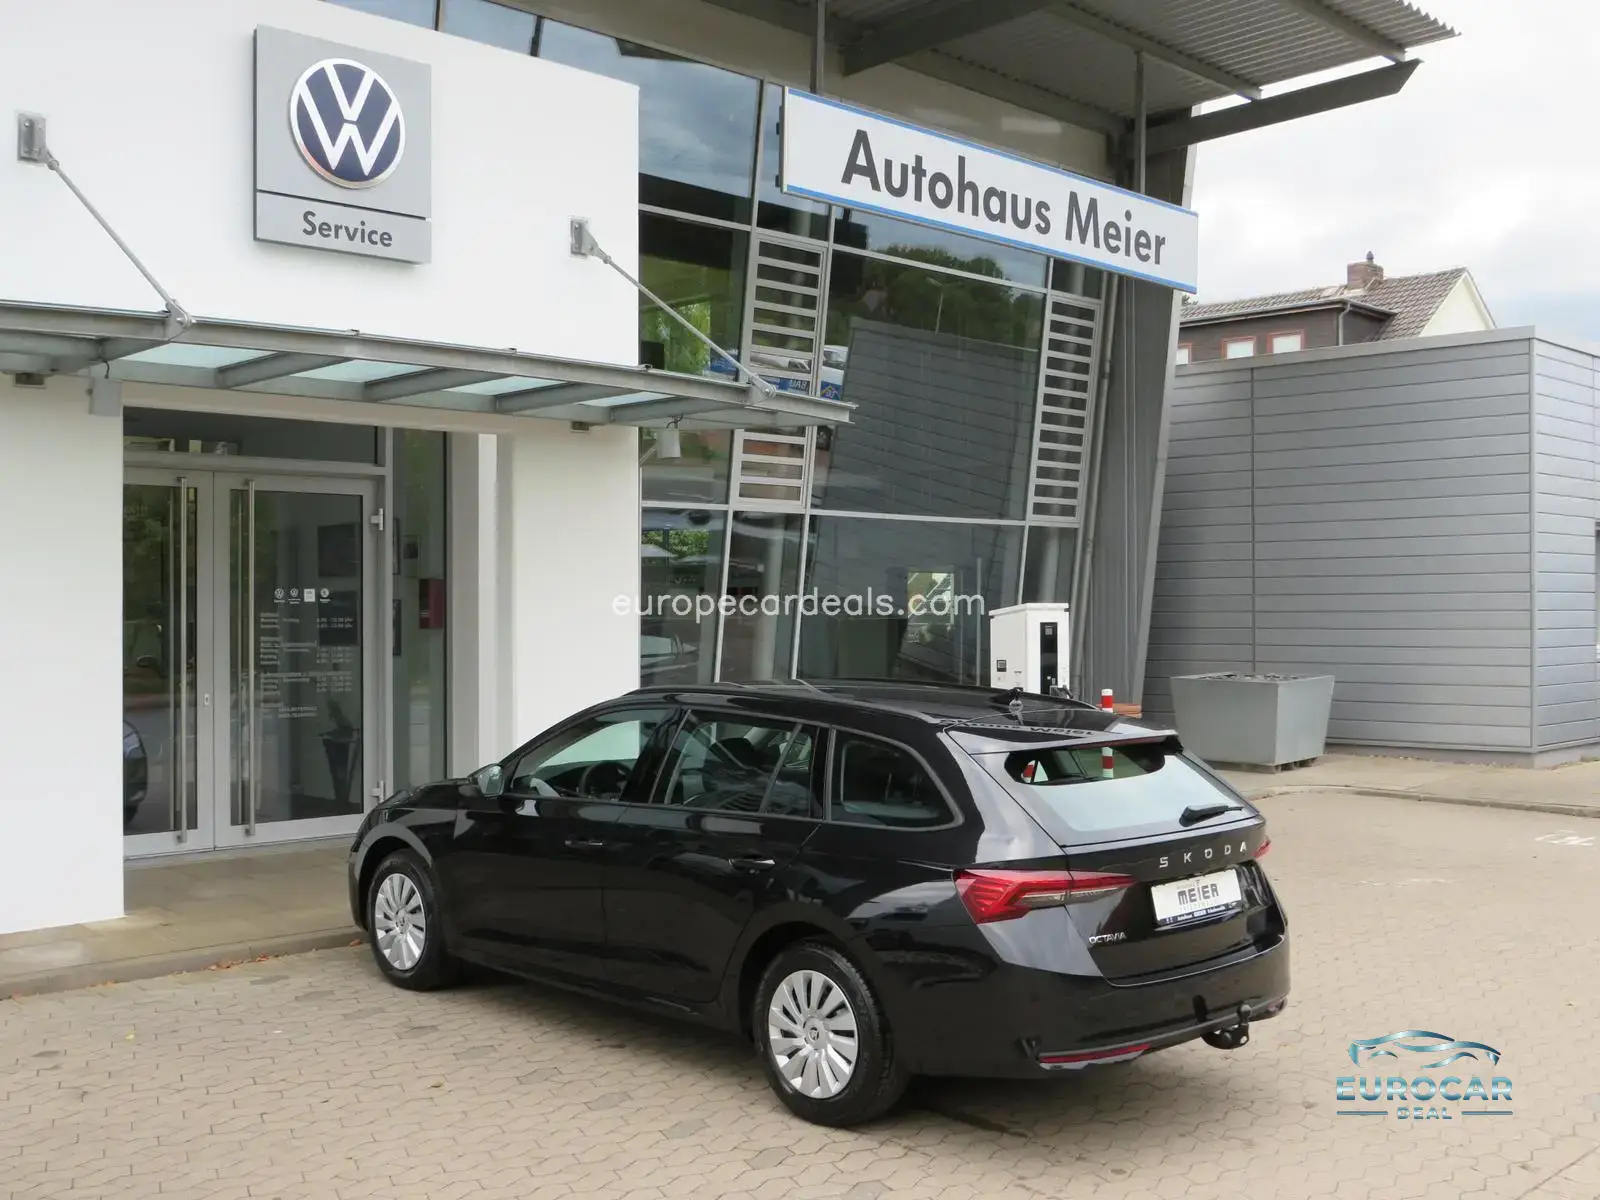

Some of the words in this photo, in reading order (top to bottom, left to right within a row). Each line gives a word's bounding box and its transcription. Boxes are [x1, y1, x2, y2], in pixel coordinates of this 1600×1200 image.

[841, 129, 1051, 235] Autohaus
[1065, 191, 1166, 265] Meier
[302, 211, 393, 248] Service
[1159, 841, 1247, 869] SKODA
[1177, 883, 1219, 906] MEIER
[1089, 931, 1127, 944] OCTAVIA
